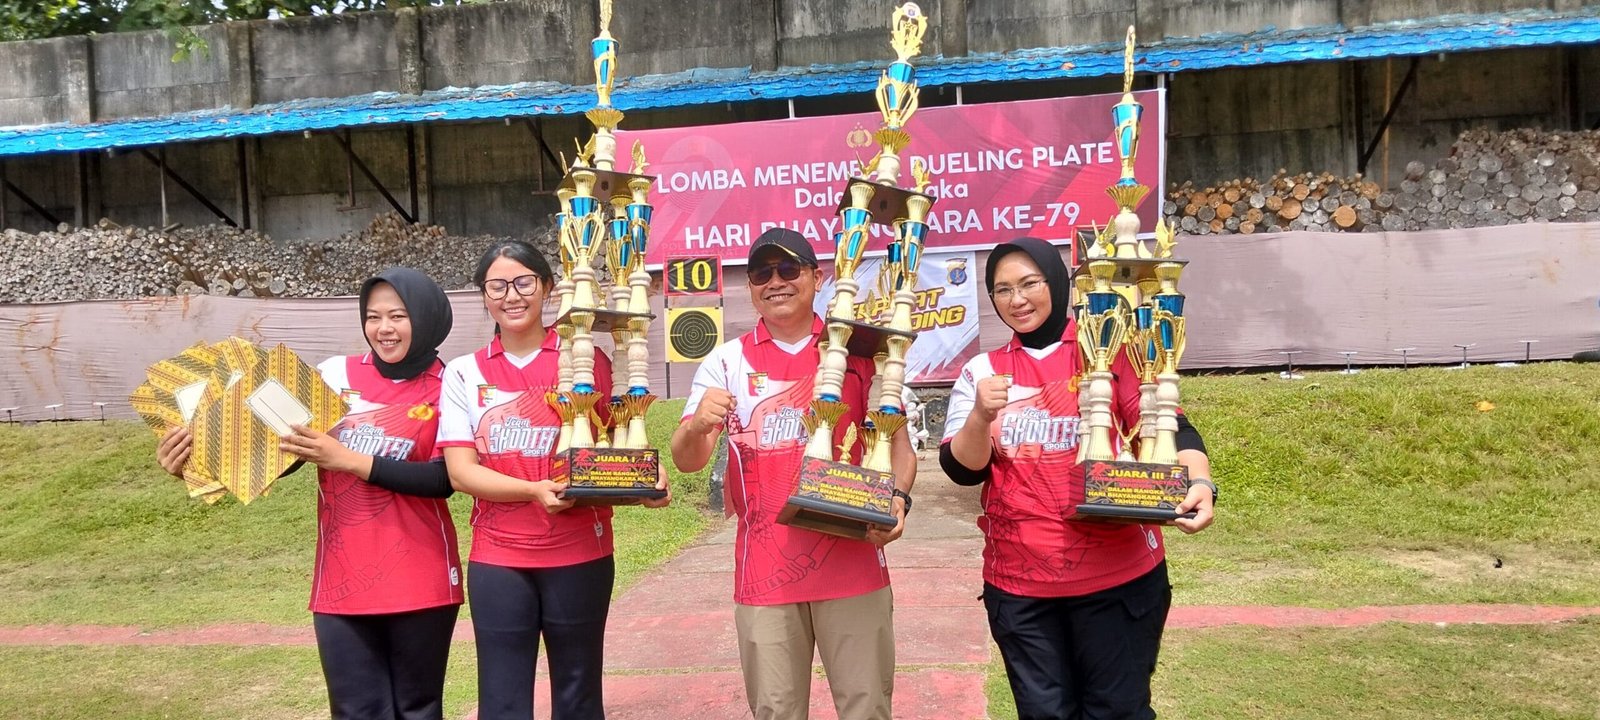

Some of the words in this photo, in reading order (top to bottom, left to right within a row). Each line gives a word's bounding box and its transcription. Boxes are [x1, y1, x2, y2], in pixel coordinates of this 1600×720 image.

[657, 168, 747, 194] LOMBA
[910, 148, 1024, 176] DUELING
[1032, 142, 1114, 168] PLATE
[685, 223, 751, 250] HARI
[992, 202, 1081, 230] KE-79
[673, 260, 713, 291] 10
[489, 424, 561, 454] SHOOTER
[1043, 443, 1070, 451] SPORT
[594, 455, 629, 463] JUARA
[826, 468, 863, 481] JUARA
[1107, 469, 1148, 479] JUARA
[1152, 472, 1165, 480] III
[1134, 487, 1164, 495] RANGKA
